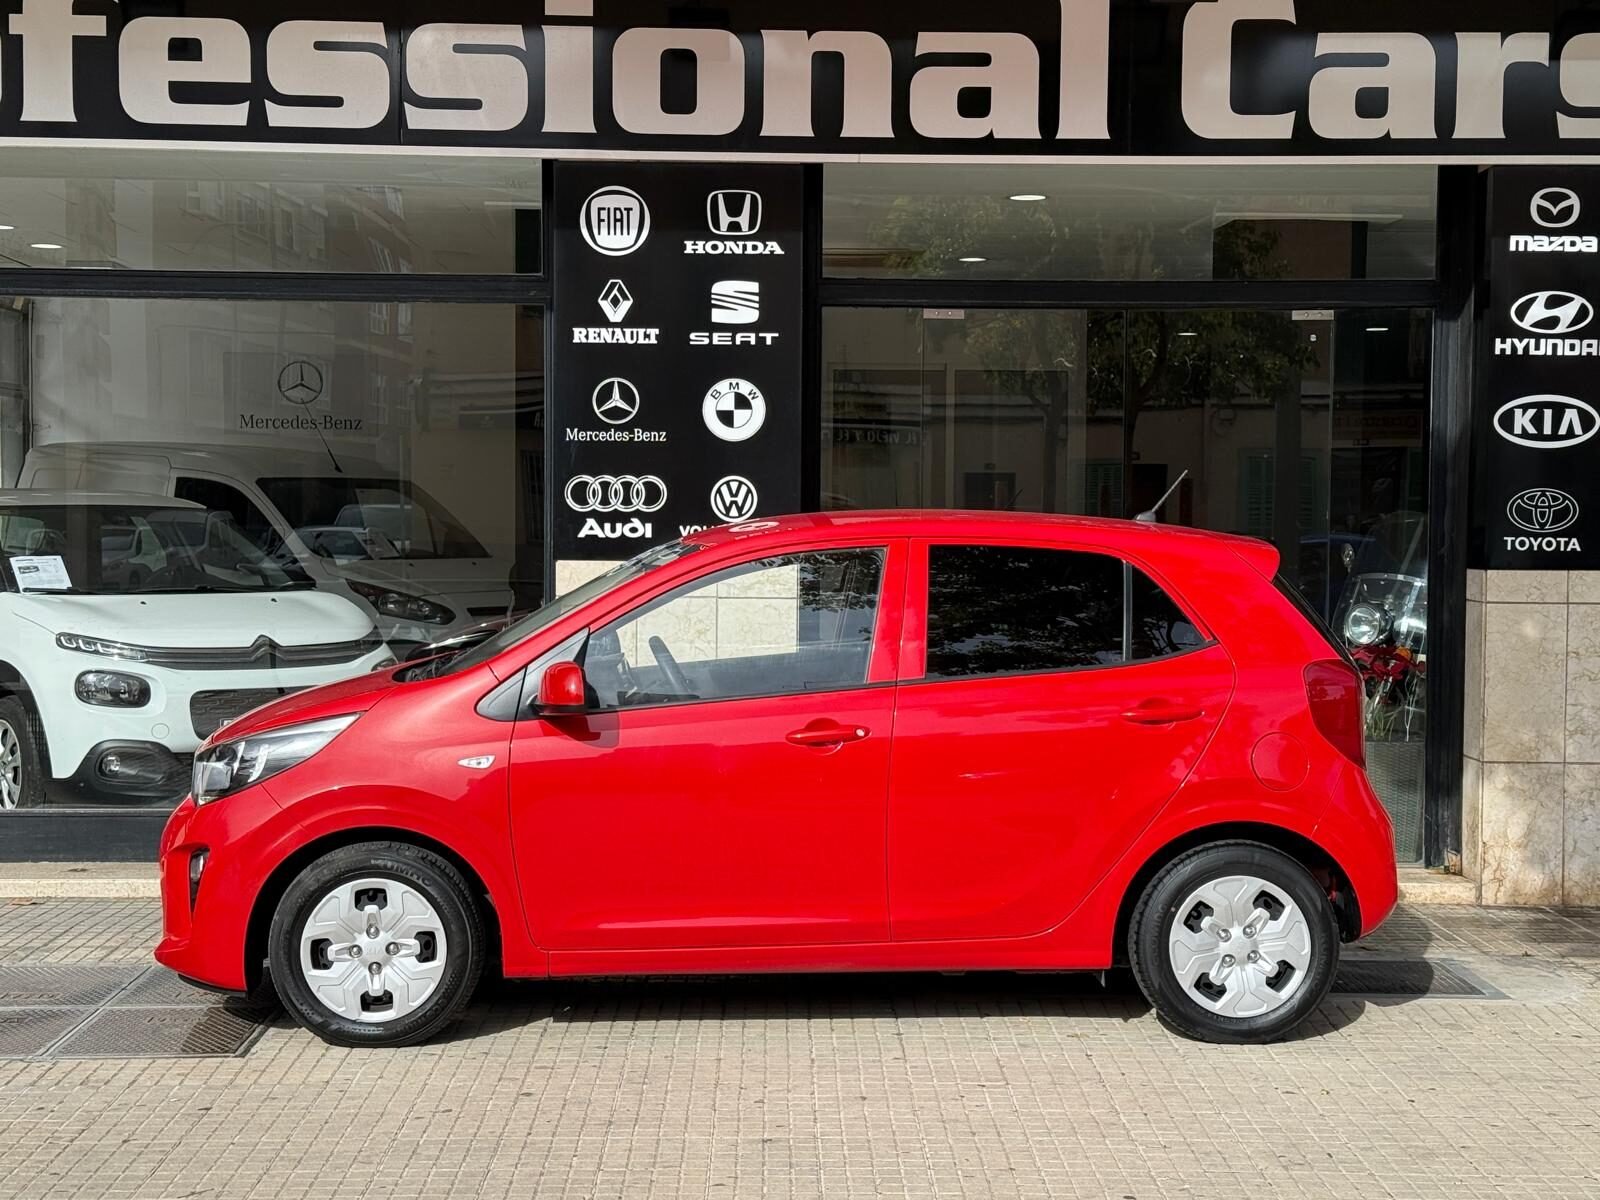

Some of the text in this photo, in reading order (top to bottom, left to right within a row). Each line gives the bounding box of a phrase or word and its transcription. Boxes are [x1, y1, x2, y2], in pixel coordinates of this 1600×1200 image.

[0, 0, 1111, 139] fessional
[598, 207, 634, 236] FIAT
[684, 241, 784, 255] HONDA
[573, 328, 659, 344] RENAULT
[689, 332, 779, 345] SEAT
[1495, 338, 1600, 356] HYUNDA
[709, 381, 760, 401] BMW
[240, 414, 363, 430] Mercedes-Benz
[1513, 408, 1584, 436] KIA
[565, 428, 666, 442] Mercedes-Benz
[577, 518, 652, 538] Audi
[1503, 536, 1581, 552] TOYOTA
